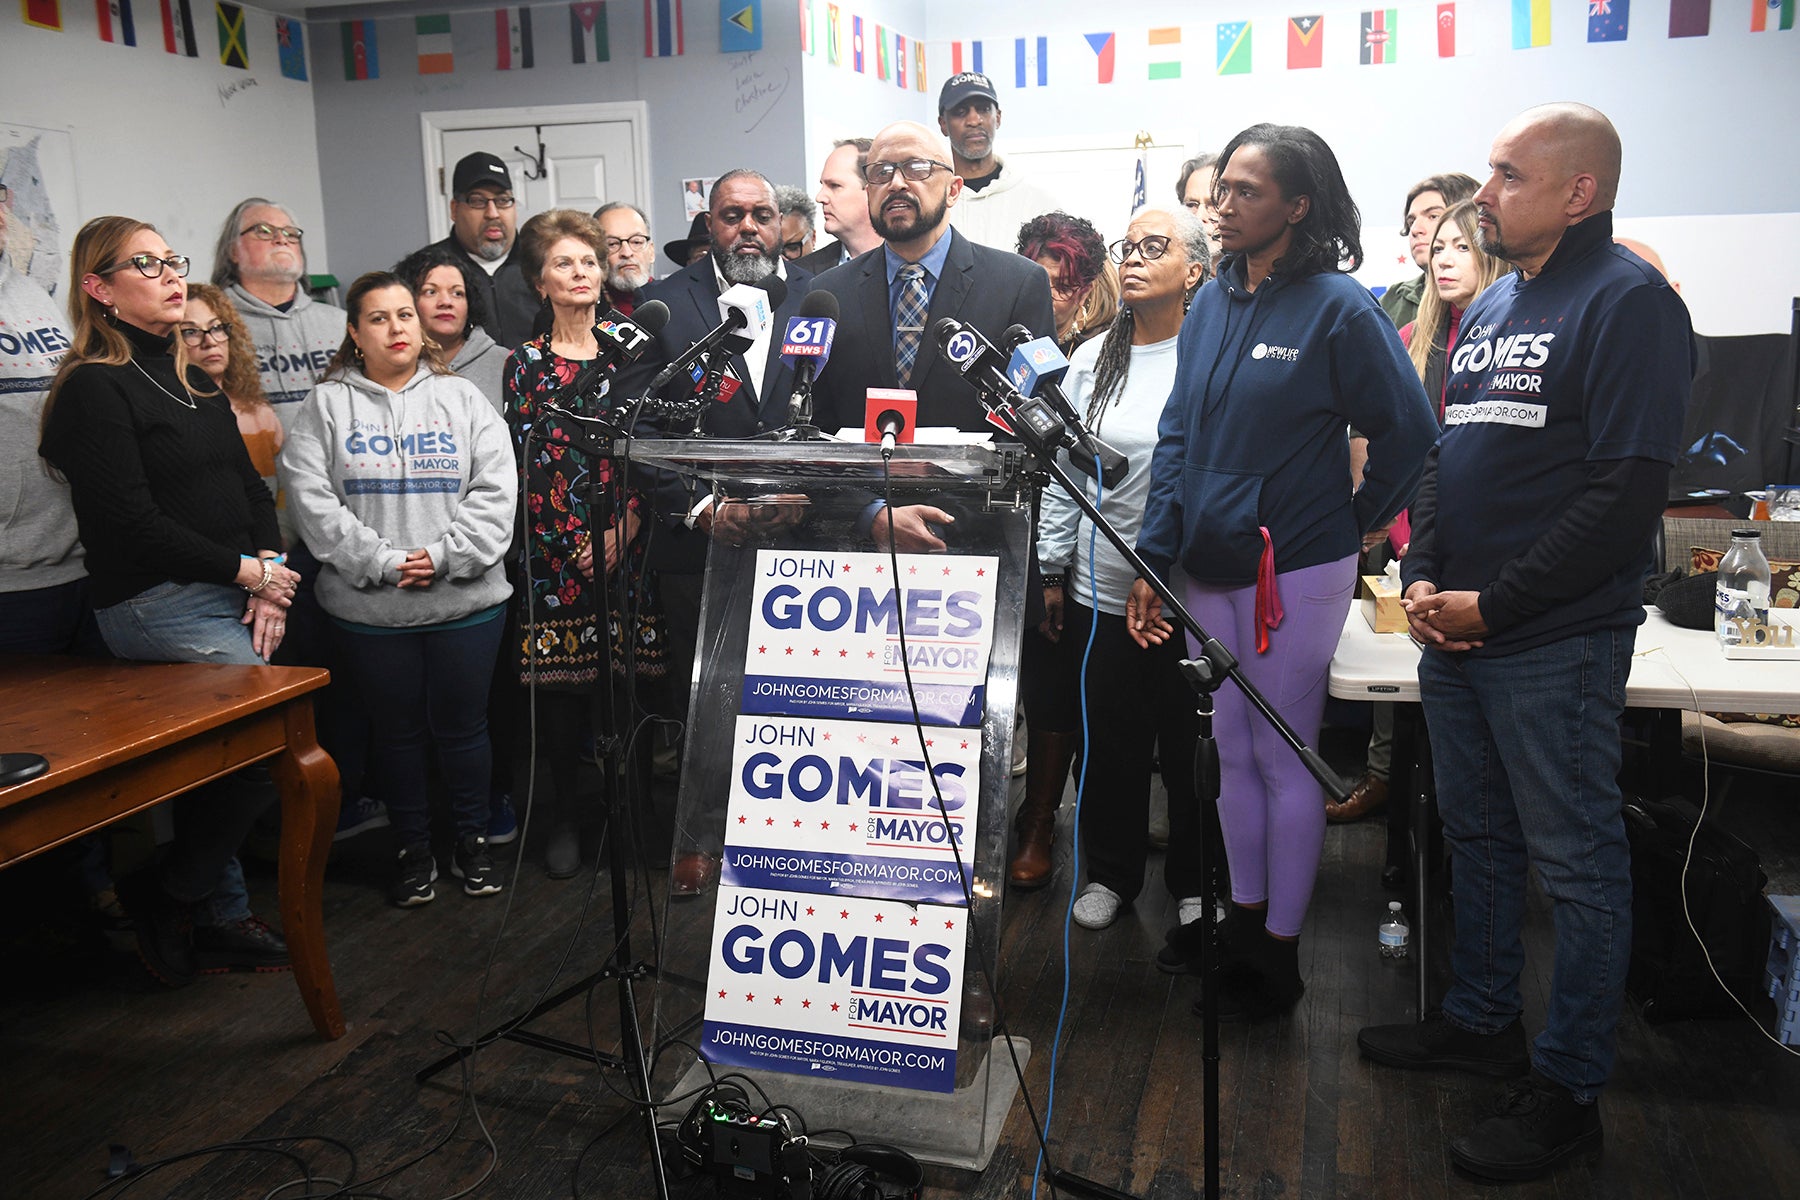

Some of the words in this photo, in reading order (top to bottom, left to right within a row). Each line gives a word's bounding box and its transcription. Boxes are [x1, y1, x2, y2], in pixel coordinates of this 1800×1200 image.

[614, 322, 649, 350] CT
[790, 320, 824, 344] 61
[785, 346, 820, 354] NEWS
[1452, 332, 1556, 374] GOMES
[1492, 374, 1542, 393] MAYOR
[346, 418, 380, 432] JOHN
[346, 432, 456, 456] GOMES
[414, 458, 459, 470] MAYOR
[766, 558, 834, 578] JOHN
[762, 584, 983, 638] GOMES
[884, 644, 892, 665] FOR
[892, 644, 980, 670] MAYOR
[752, 683, 976, 706] JOHNGOMESFORMAYOR.COM
[746, 724, 814, 746] JOHN
[742, 752, 966, 812] GOMES
[867, 818, 876, 839] FOR
[876, 818, 964, 845] MAYOR
[732, 854, 962, 884] JOHNGOMESFORMAYOR.COM
[726, 895, 798, 922] JOHN
[722, 924, 952, 995] GOMES
[848, 998, 858, 1020] FOR
[858, 998, 947, 1031] MAYOR
[712, 1029, 946, 1071] JOHNGOMESFORMAYOR.COM
